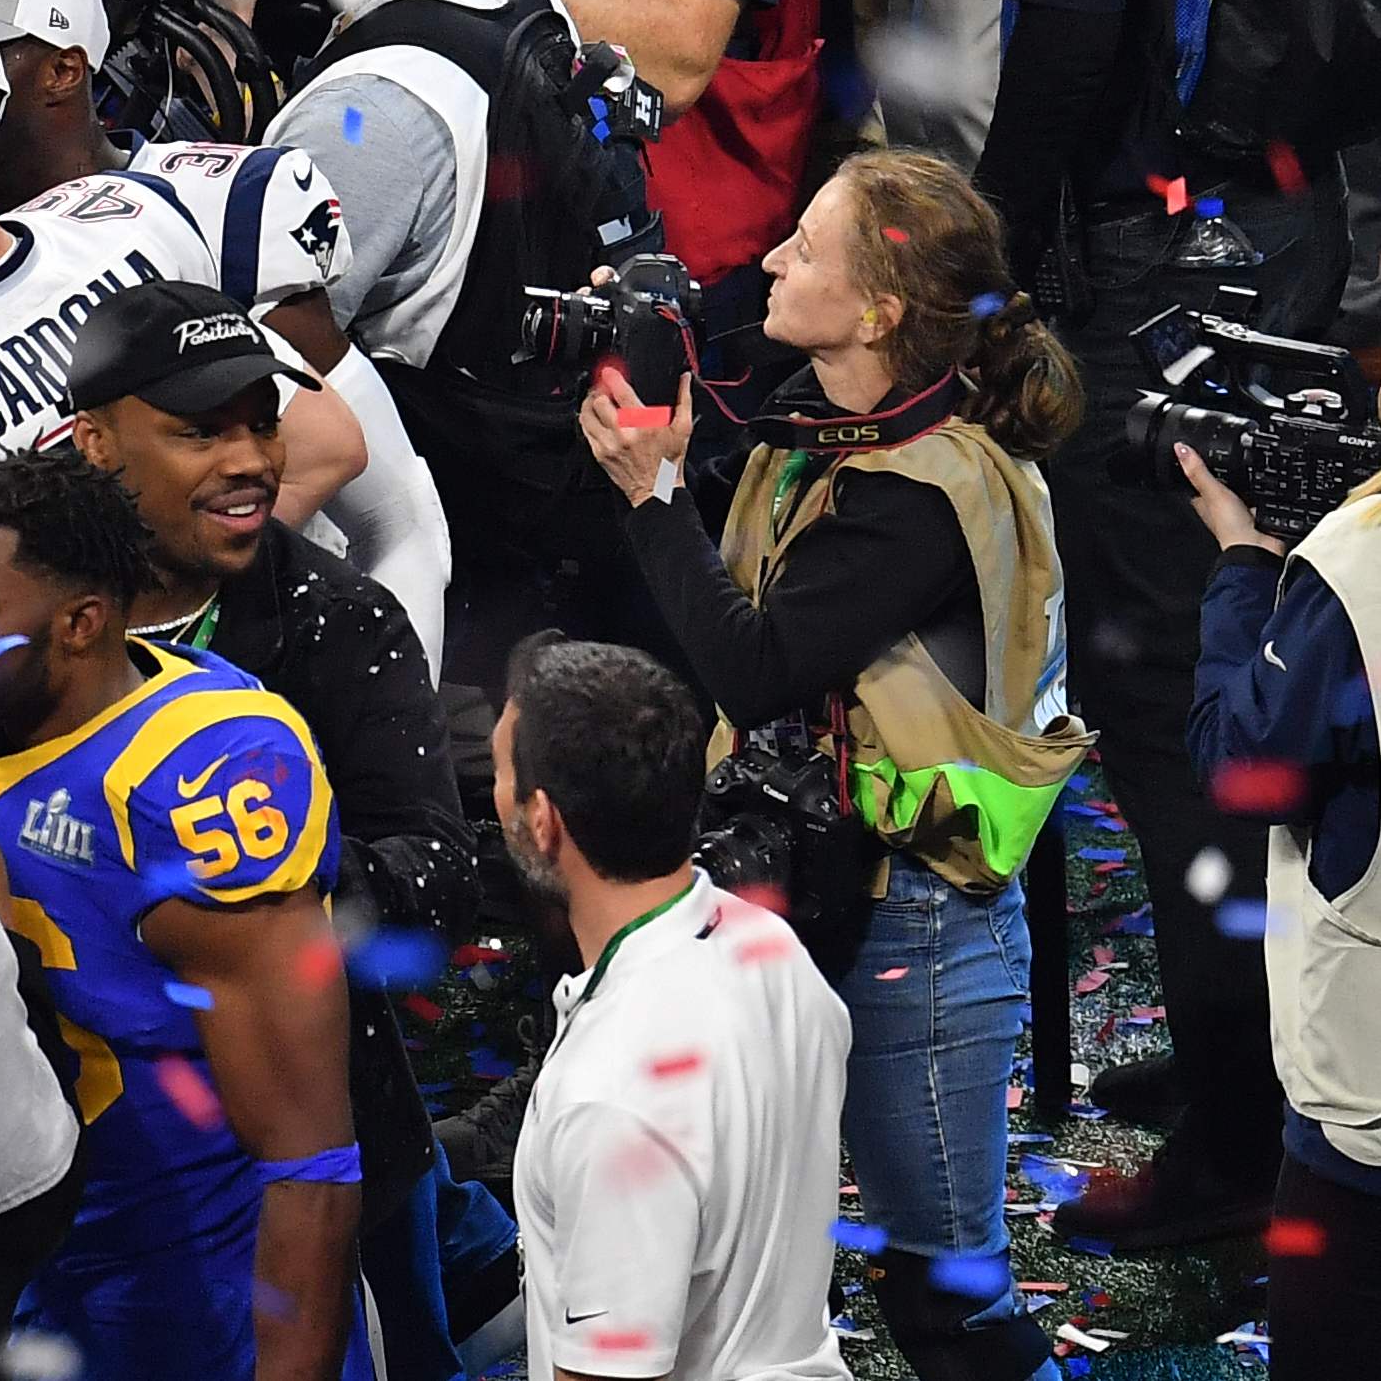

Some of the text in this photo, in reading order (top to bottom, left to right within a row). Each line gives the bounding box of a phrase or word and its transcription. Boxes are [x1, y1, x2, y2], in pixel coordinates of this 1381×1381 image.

[172, 318, 260, 355] Positivity
[817, 424, 880, 444] EOS
[1338, 435, 1377, 448] SONY
[169, 777, 288, 881] 56
